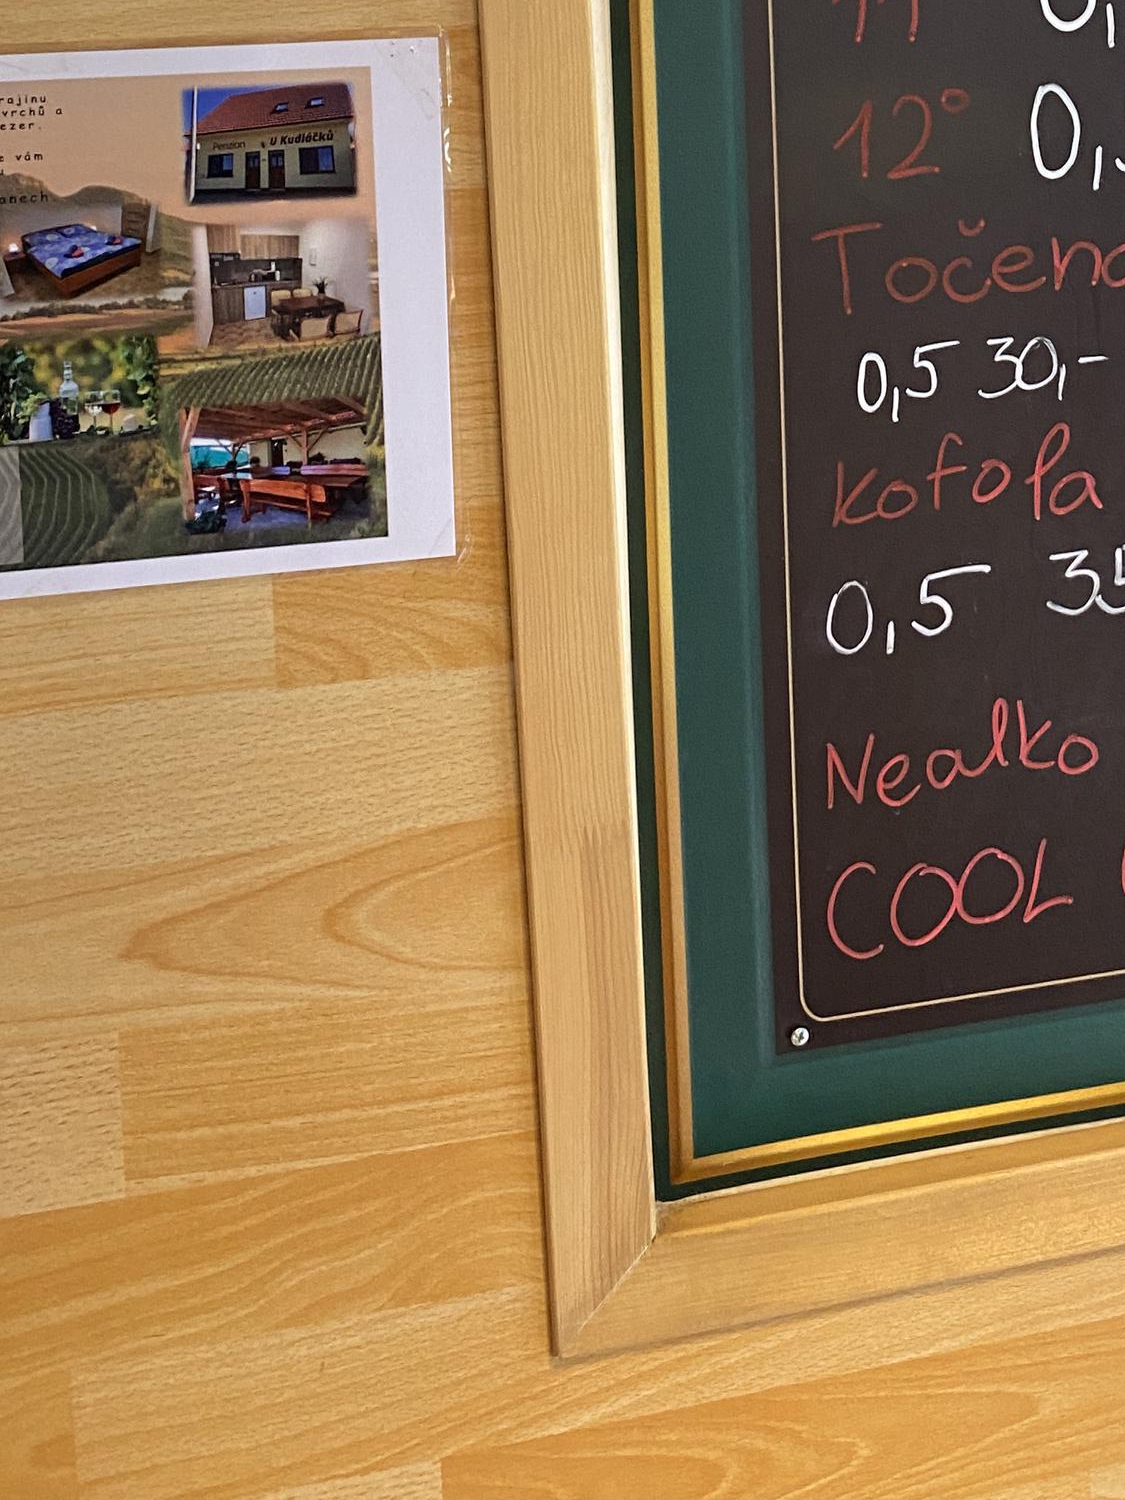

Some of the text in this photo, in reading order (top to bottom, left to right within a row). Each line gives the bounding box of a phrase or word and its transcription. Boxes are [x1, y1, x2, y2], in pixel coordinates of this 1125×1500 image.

[55, 108, 62, 116] a
[857, 340, 960, 422] 0,5
[826, 564, 991, 655] 0,5
[827, 697, 1099, 809] Nealko
[827, 838, 1073, 960] COOL
